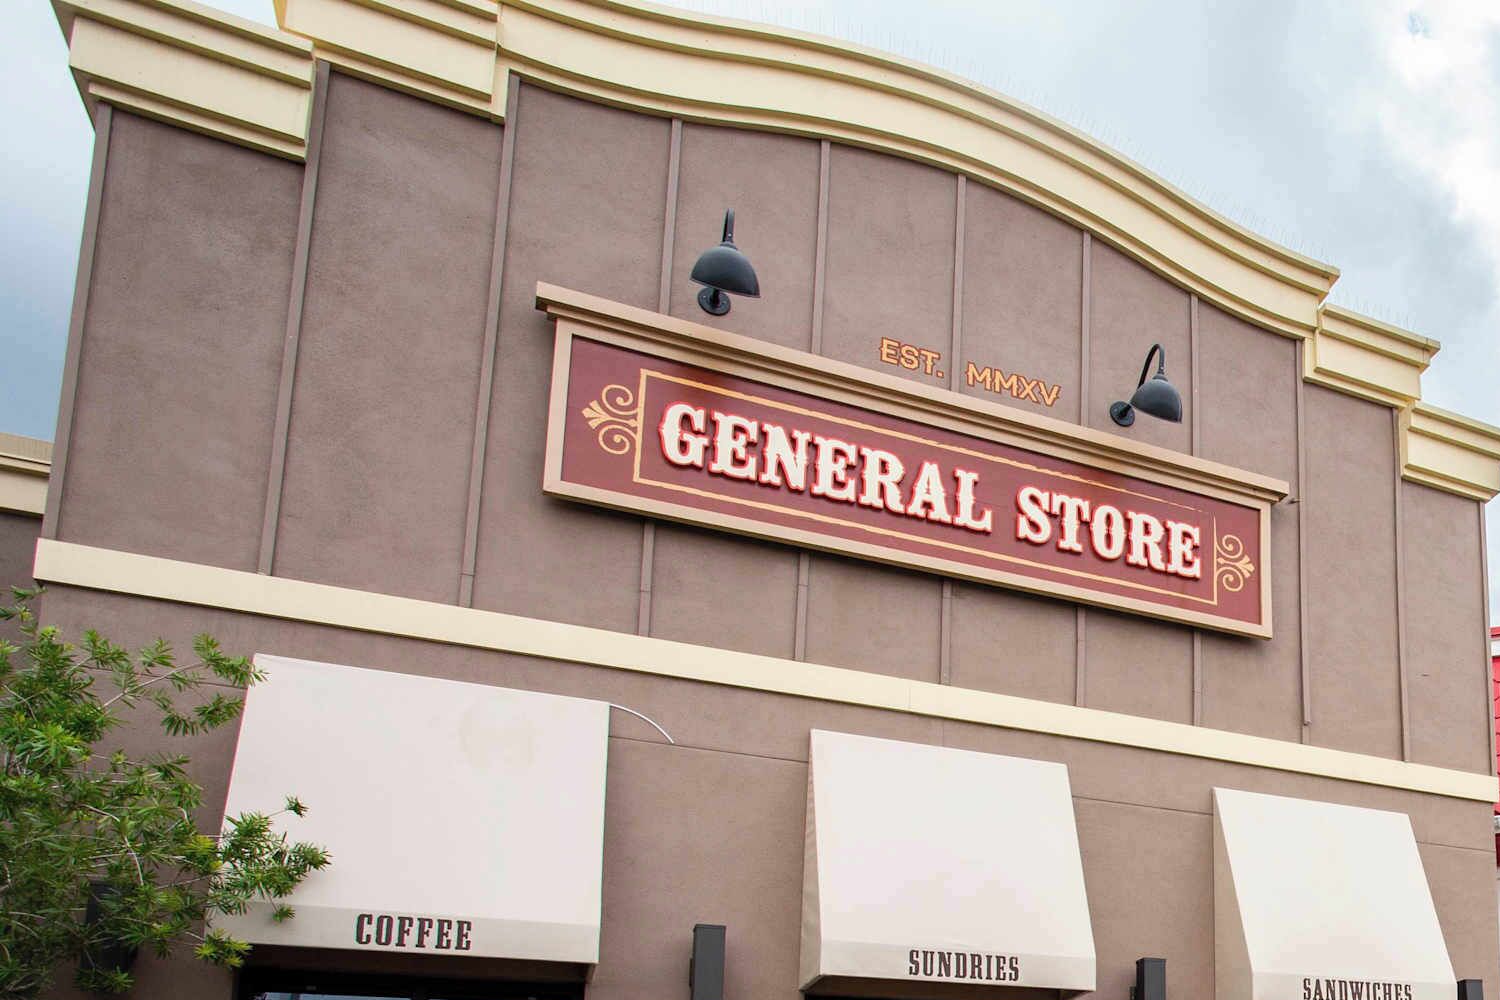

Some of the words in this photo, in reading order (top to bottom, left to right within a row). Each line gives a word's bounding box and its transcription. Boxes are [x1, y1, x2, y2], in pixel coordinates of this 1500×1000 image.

[879, 337, 945, 378] EST.
[965, 361, 1061, 409] MMXV
[658, 400, 993, 534] GENERAL
[1016, 486, 1201, 580] STORE
[355, 914, 472, 950] COFFEE
[908, 949, 1020, 981] SUNDRIES
